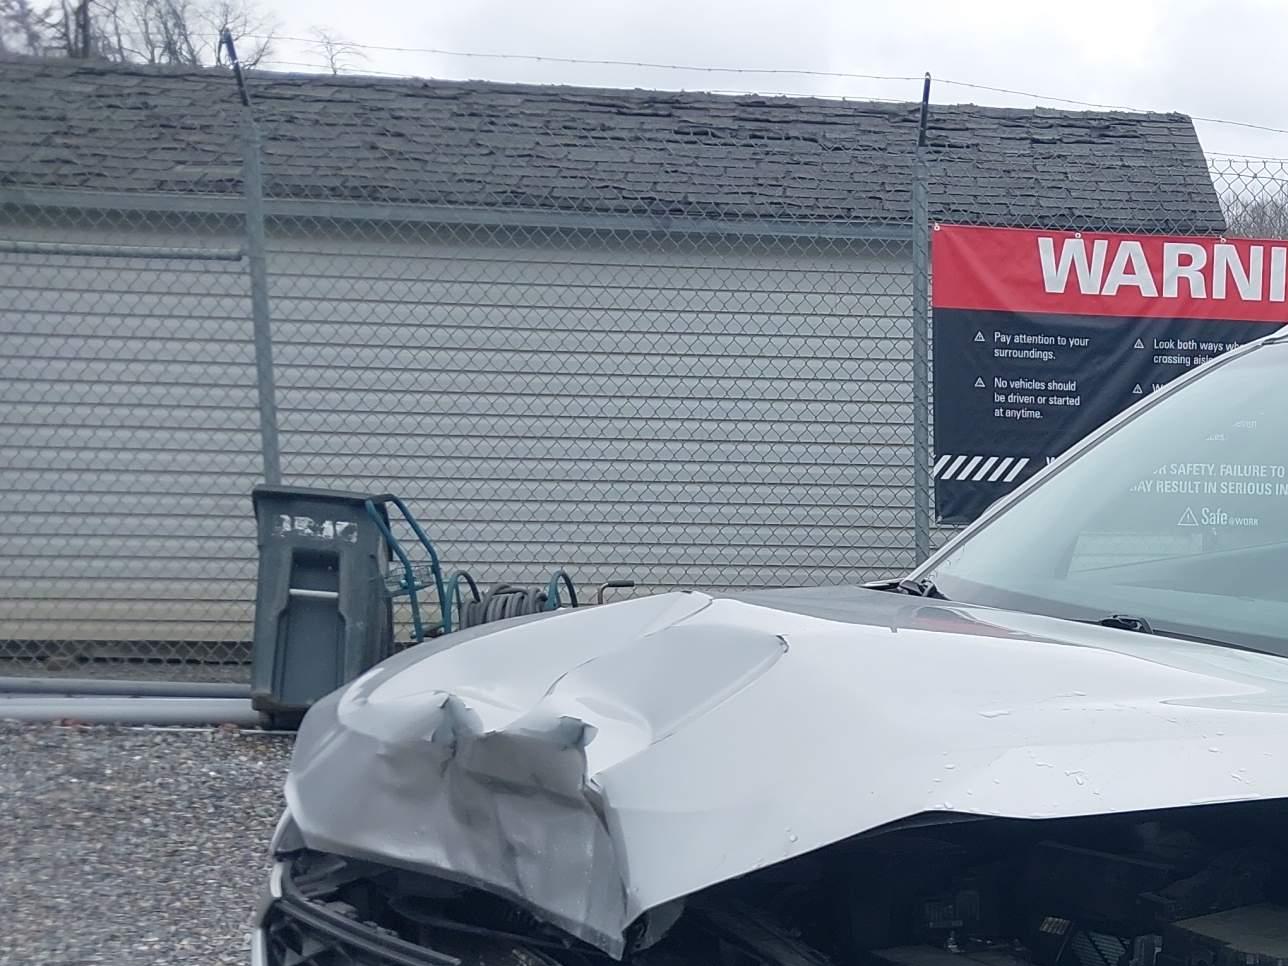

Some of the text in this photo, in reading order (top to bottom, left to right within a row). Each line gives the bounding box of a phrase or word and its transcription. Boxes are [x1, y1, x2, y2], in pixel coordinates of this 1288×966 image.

[994, 331, 1090, 348] Pay attention to your
[1154, 338, 1175, 350] Look
[1177, 339, 1198, 350] both
[1200, 341, 1223, 353] ways
[994, 348, 1056, 361] surroundings.
[1153, 354, 1191, 366] crossing
[994, 377, 1076, 391] No vehicles should
[994, 393, 1081, 406] be driven or started
[994, 408, 1043, 420] at anytime.
[1170, 463, 1216, 476] SAFETY.
[1220, 465, 1267, 477] FAILURE
[1270, 465, 1285, 478] TO
[1157, 481, 1200, 493] RESULT
[1204, 482, 1217, 493] IN
[1220, 482, 1272, 495] SERIOUS
